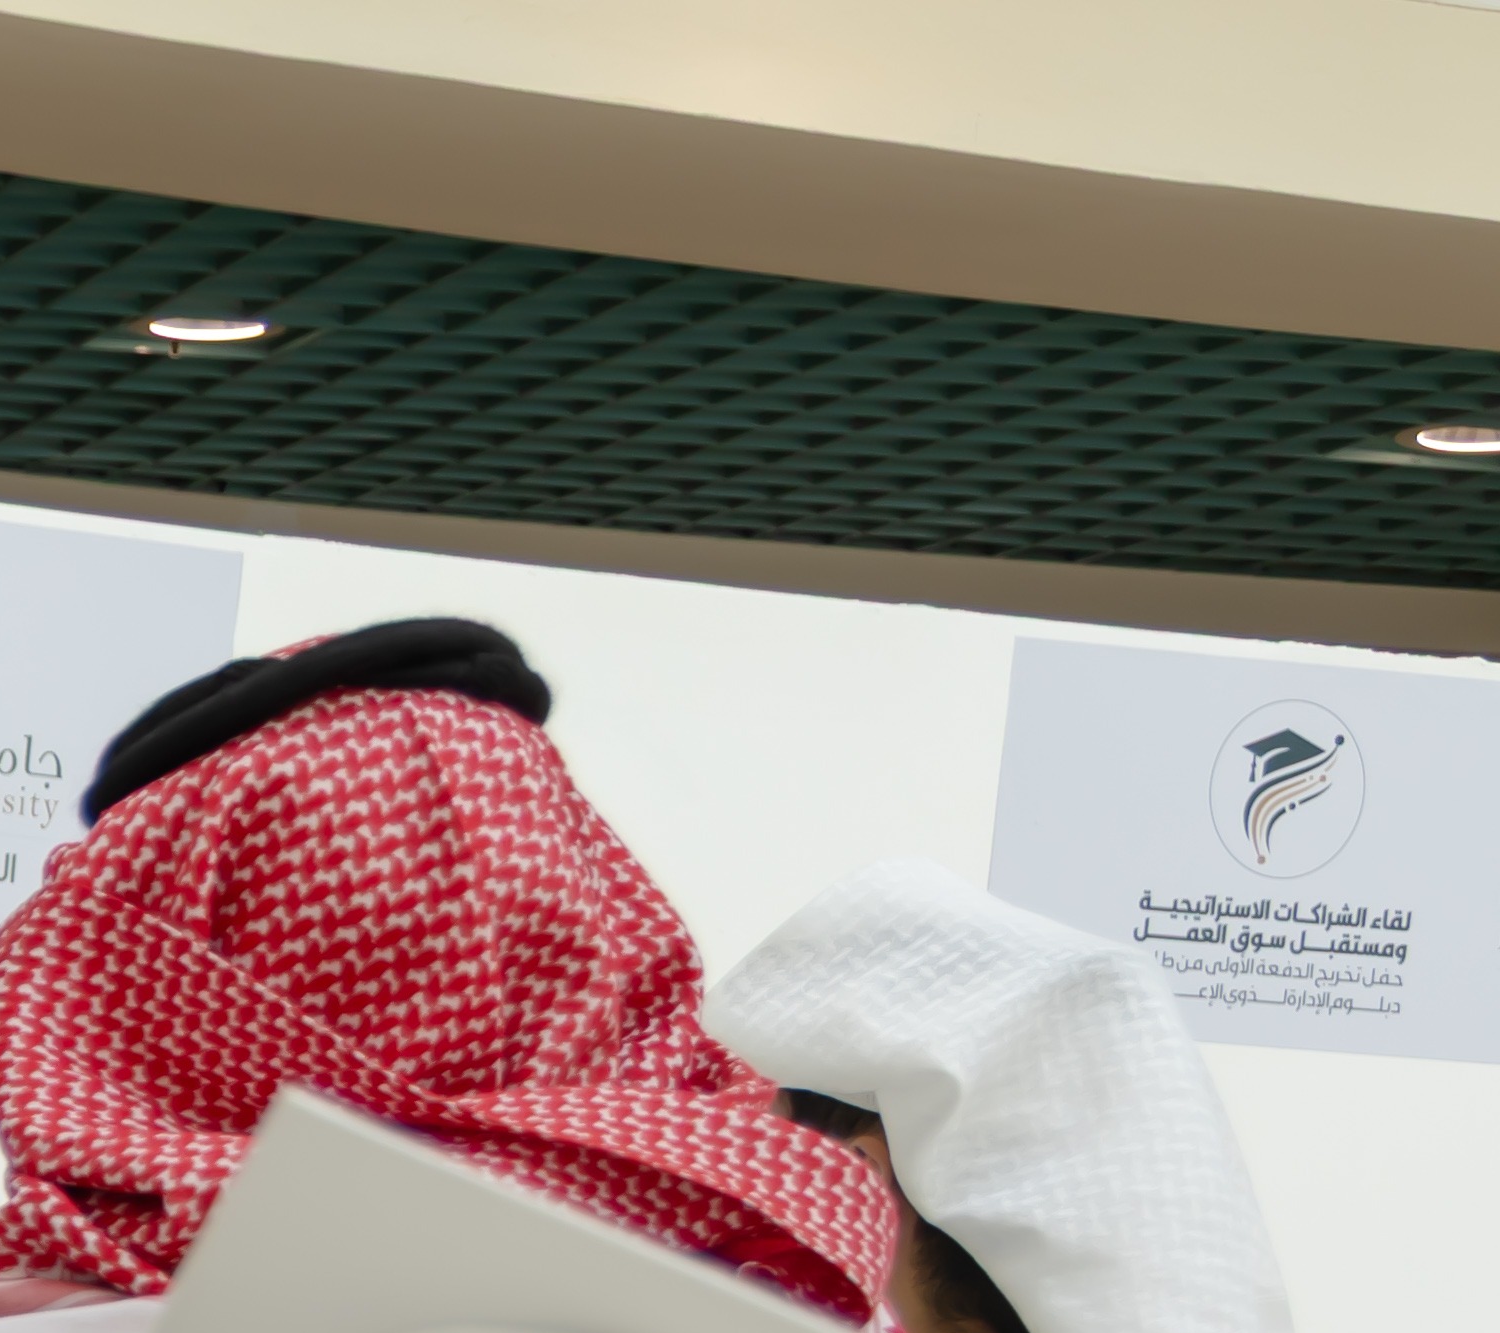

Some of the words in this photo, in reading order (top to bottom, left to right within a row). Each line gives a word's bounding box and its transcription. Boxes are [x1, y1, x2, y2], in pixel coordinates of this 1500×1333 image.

[1139, 890, 1270, 922] الاستراتيجية
[1274, 902, 1367, 931] الشراكات
[1133, 917, 1227, 944] العمل
[1369, 907, 1412, 932] لقاء
[1230, 925, 1286, 954] سوق
[1289, 930, 1408, 965] ومستقبل
[1176, 955, 1203, 972] من
[1205, 952, 1255, 979] الأولى
[1255, 960, 1314, 980] الدفعة
[1315, 965, 1362, 988] تخريج
[1362, 966, 1404, 988] حفل
[1173, 983, 1223, 1008] الإع
[1287, 990, 1331, 1017] الإدارة
[1329, 995, 1401, 1020] دبلوم
